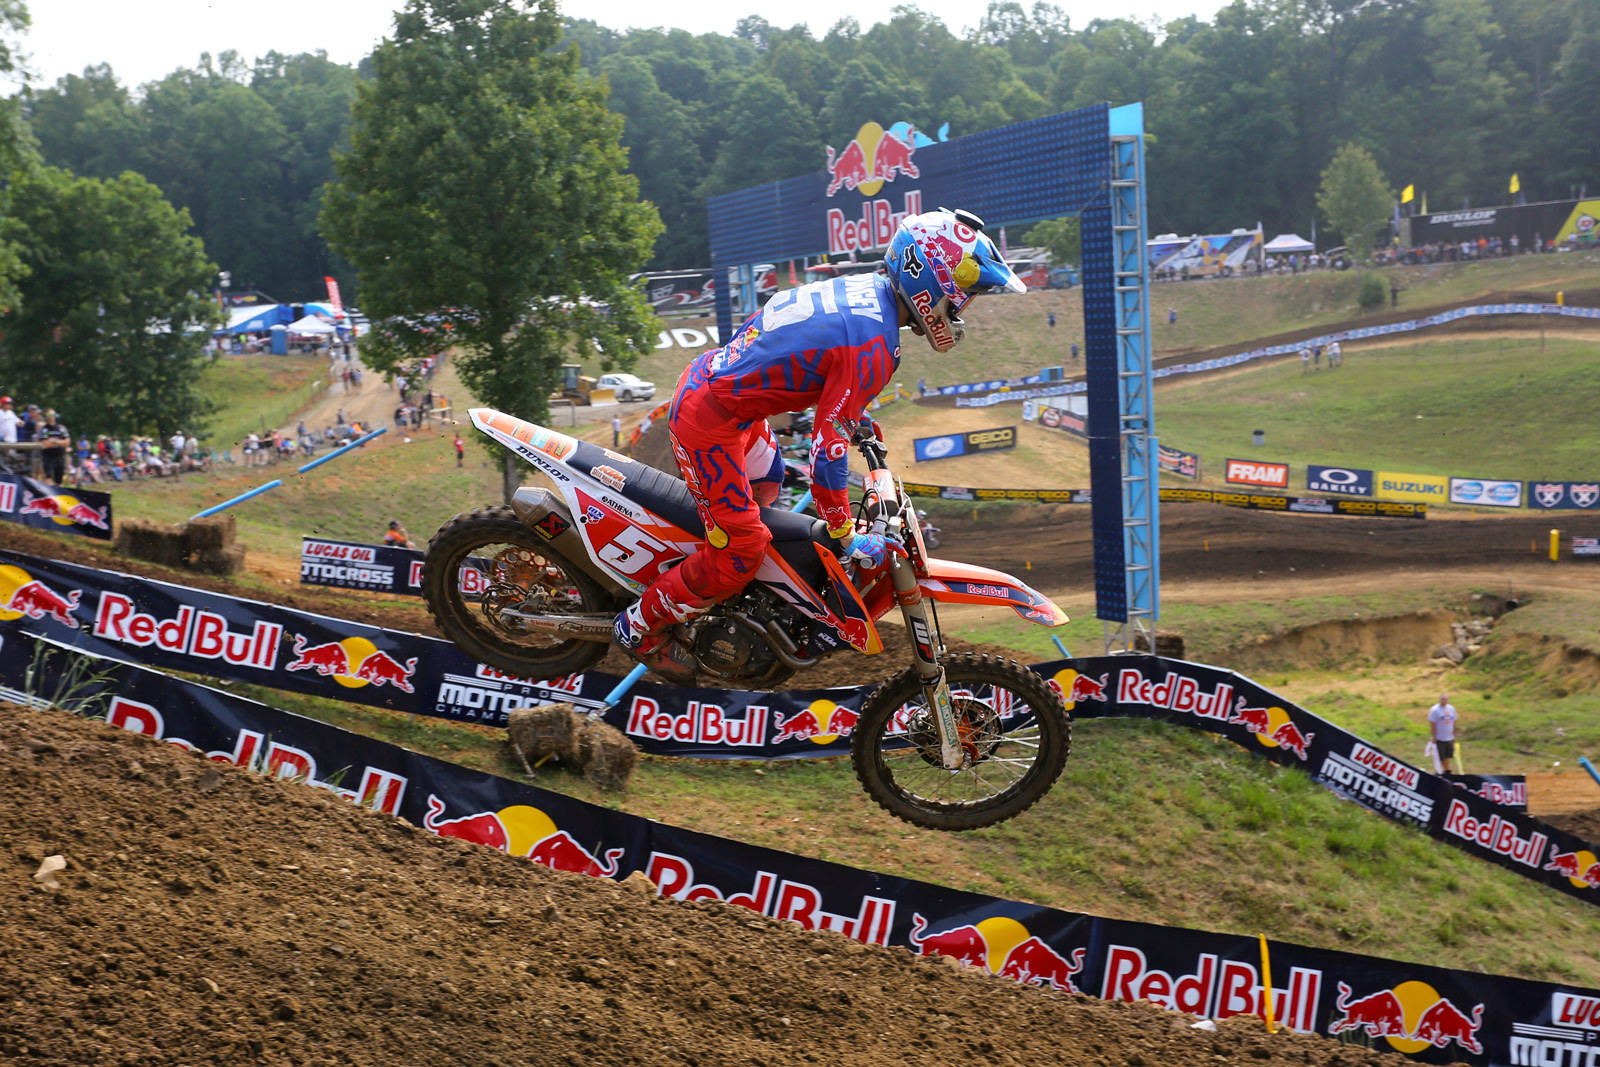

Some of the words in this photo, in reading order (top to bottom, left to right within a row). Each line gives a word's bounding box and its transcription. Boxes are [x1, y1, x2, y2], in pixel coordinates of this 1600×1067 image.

[1430, 209, 1496, 224] DUNLOP
[763, 280, 838, 331] 5
[968, 430, 1013, 445] GEICO
[516, 446, 570, 482] DUNLOP
[1228, 463, 1285, 483] FRAM
[1310, 482, 1367, 494] OAKLEY
[1382, 481, 1443, 495] SUZUKI
[607, 498, 633, 518] ATHENA
[306, 543, 349, 559] LUCAS
[351, 548, 371, 561] OIL
[598, 525, 667, 574] 5
[302, 562, 394, 585] OTOCROSS
[502, 684, 549, 698] PRO
[1355, 748, 1396, 777] LUCAS
[1396, 768, 1416, 787] OIL
[1320, 758, 1433, 822] MOTOCROSS
[1559, 997, 1600, 1027] LUC
[1510, 1036, 1600, 1067] MOTO
